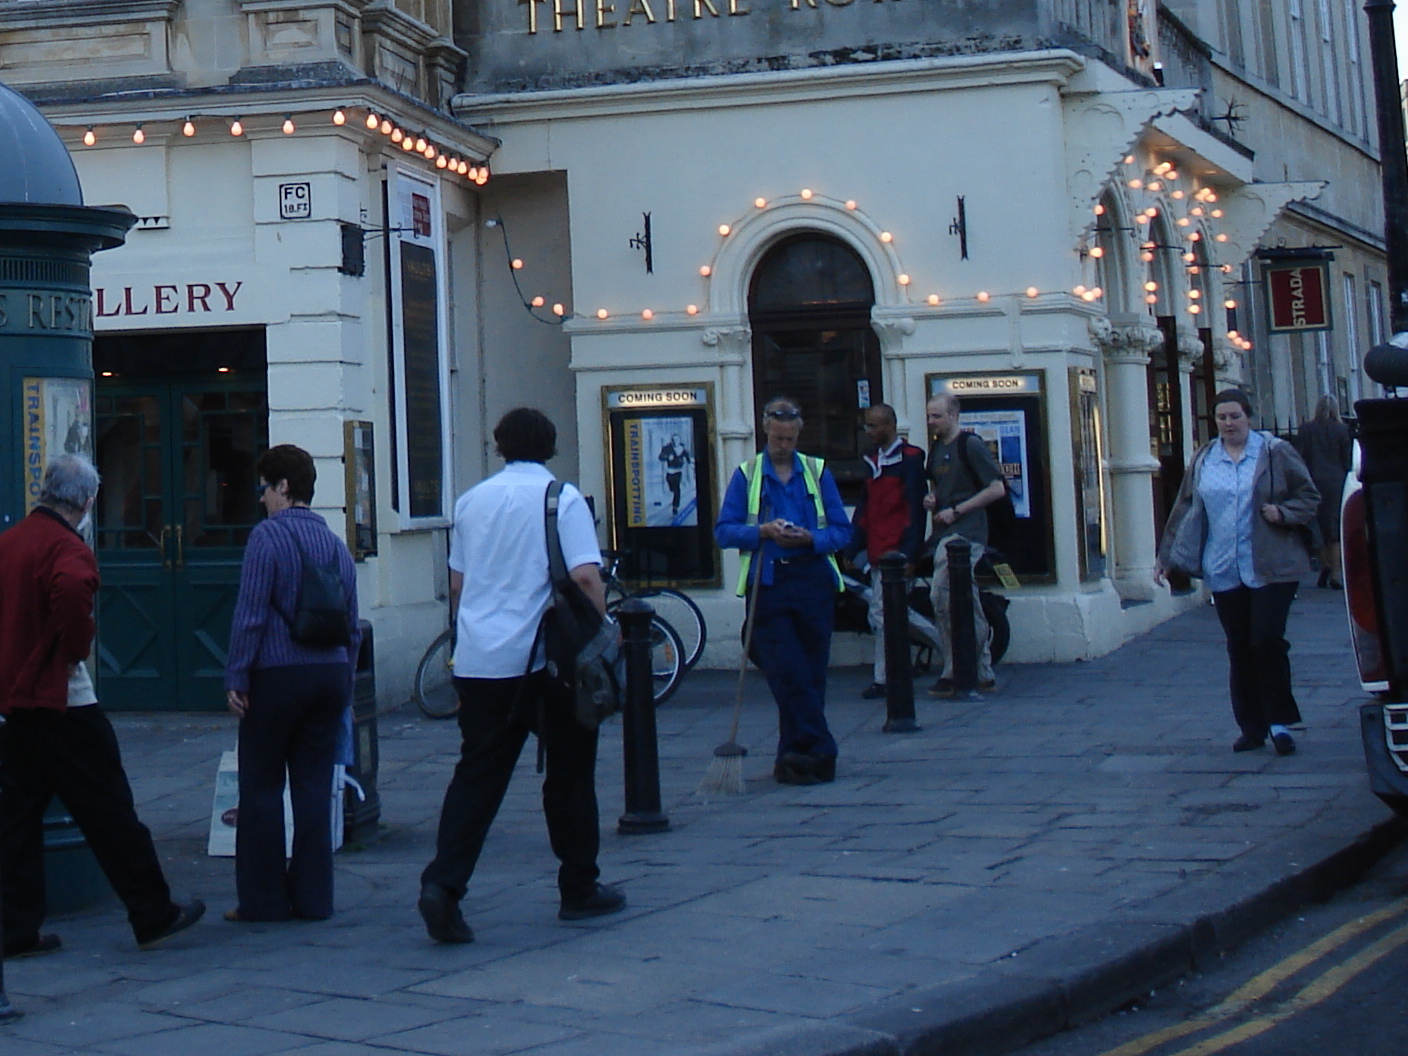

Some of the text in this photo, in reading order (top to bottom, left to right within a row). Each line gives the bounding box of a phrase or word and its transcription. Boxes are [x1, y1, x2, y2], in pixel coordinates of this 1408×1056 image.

[284, 186, 306, 200] FC
[95, 280, 244, 318] LLERY
[1289, 268, 1307, 328] STRADA
[618, 391, 698, 404] COMING SOON
[952, 379, 1019, 390] COMING SOON
[629, 423, 643, 524] TRAINSPOTTING
